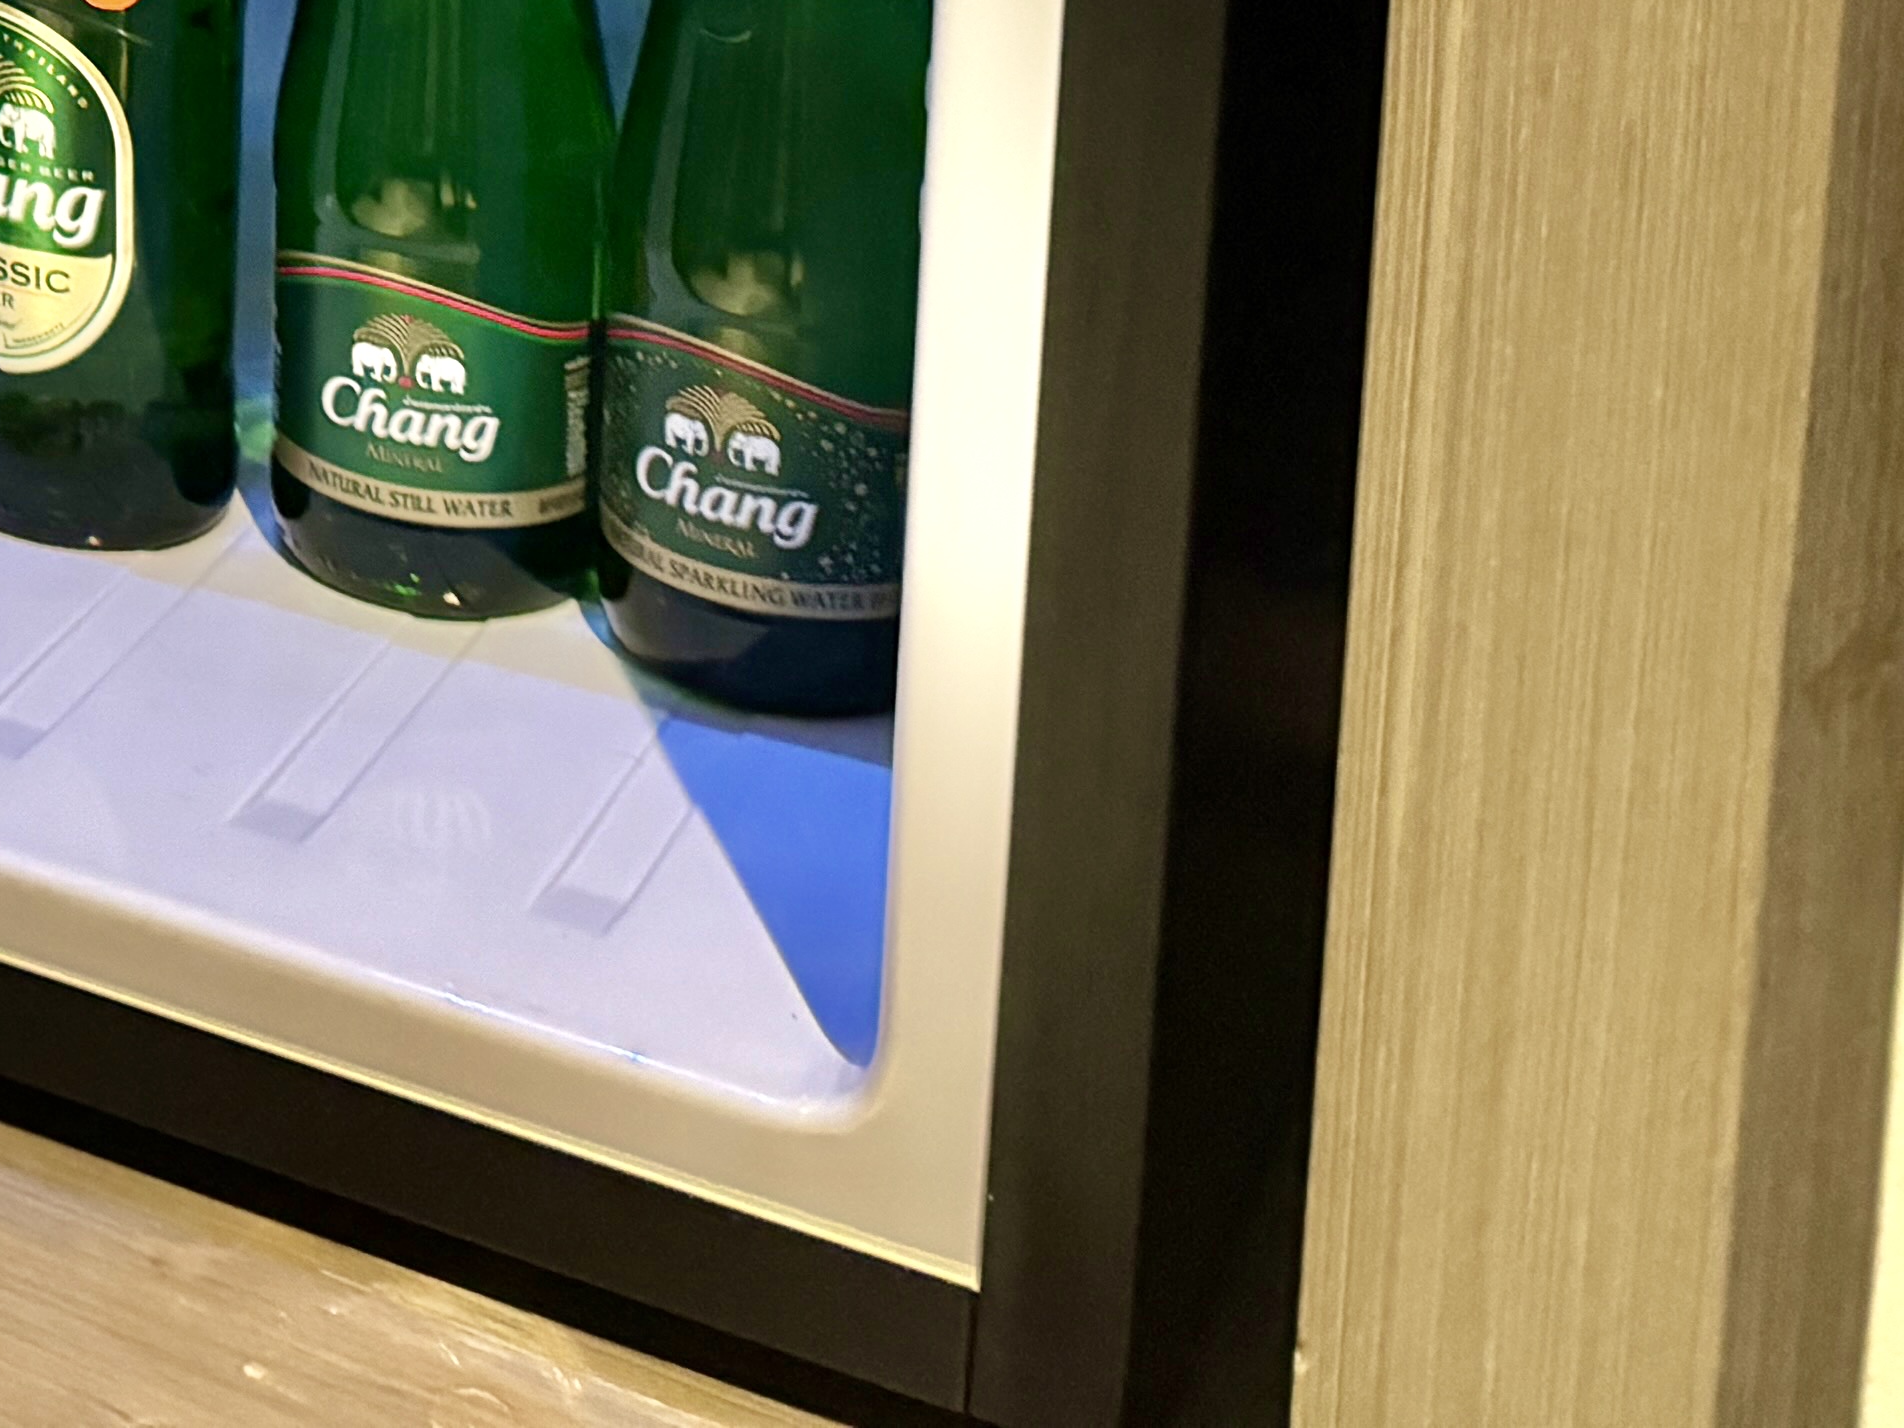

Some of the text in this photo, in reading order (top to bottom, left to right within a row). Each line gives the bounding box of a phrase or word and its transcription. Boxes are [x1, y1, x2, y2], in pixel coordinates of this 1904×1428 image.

[38, 164, 96, 182] BEER
[321, 376, 501, 463] Chang
[307, 459, 384, 504] NATURAL
[388, 490, 437, 515] STILL
[442, 498, 513, 518] WATER
[636, 445, 820, 550] Chang
[669, 558, 785, 606] SPARKLING
